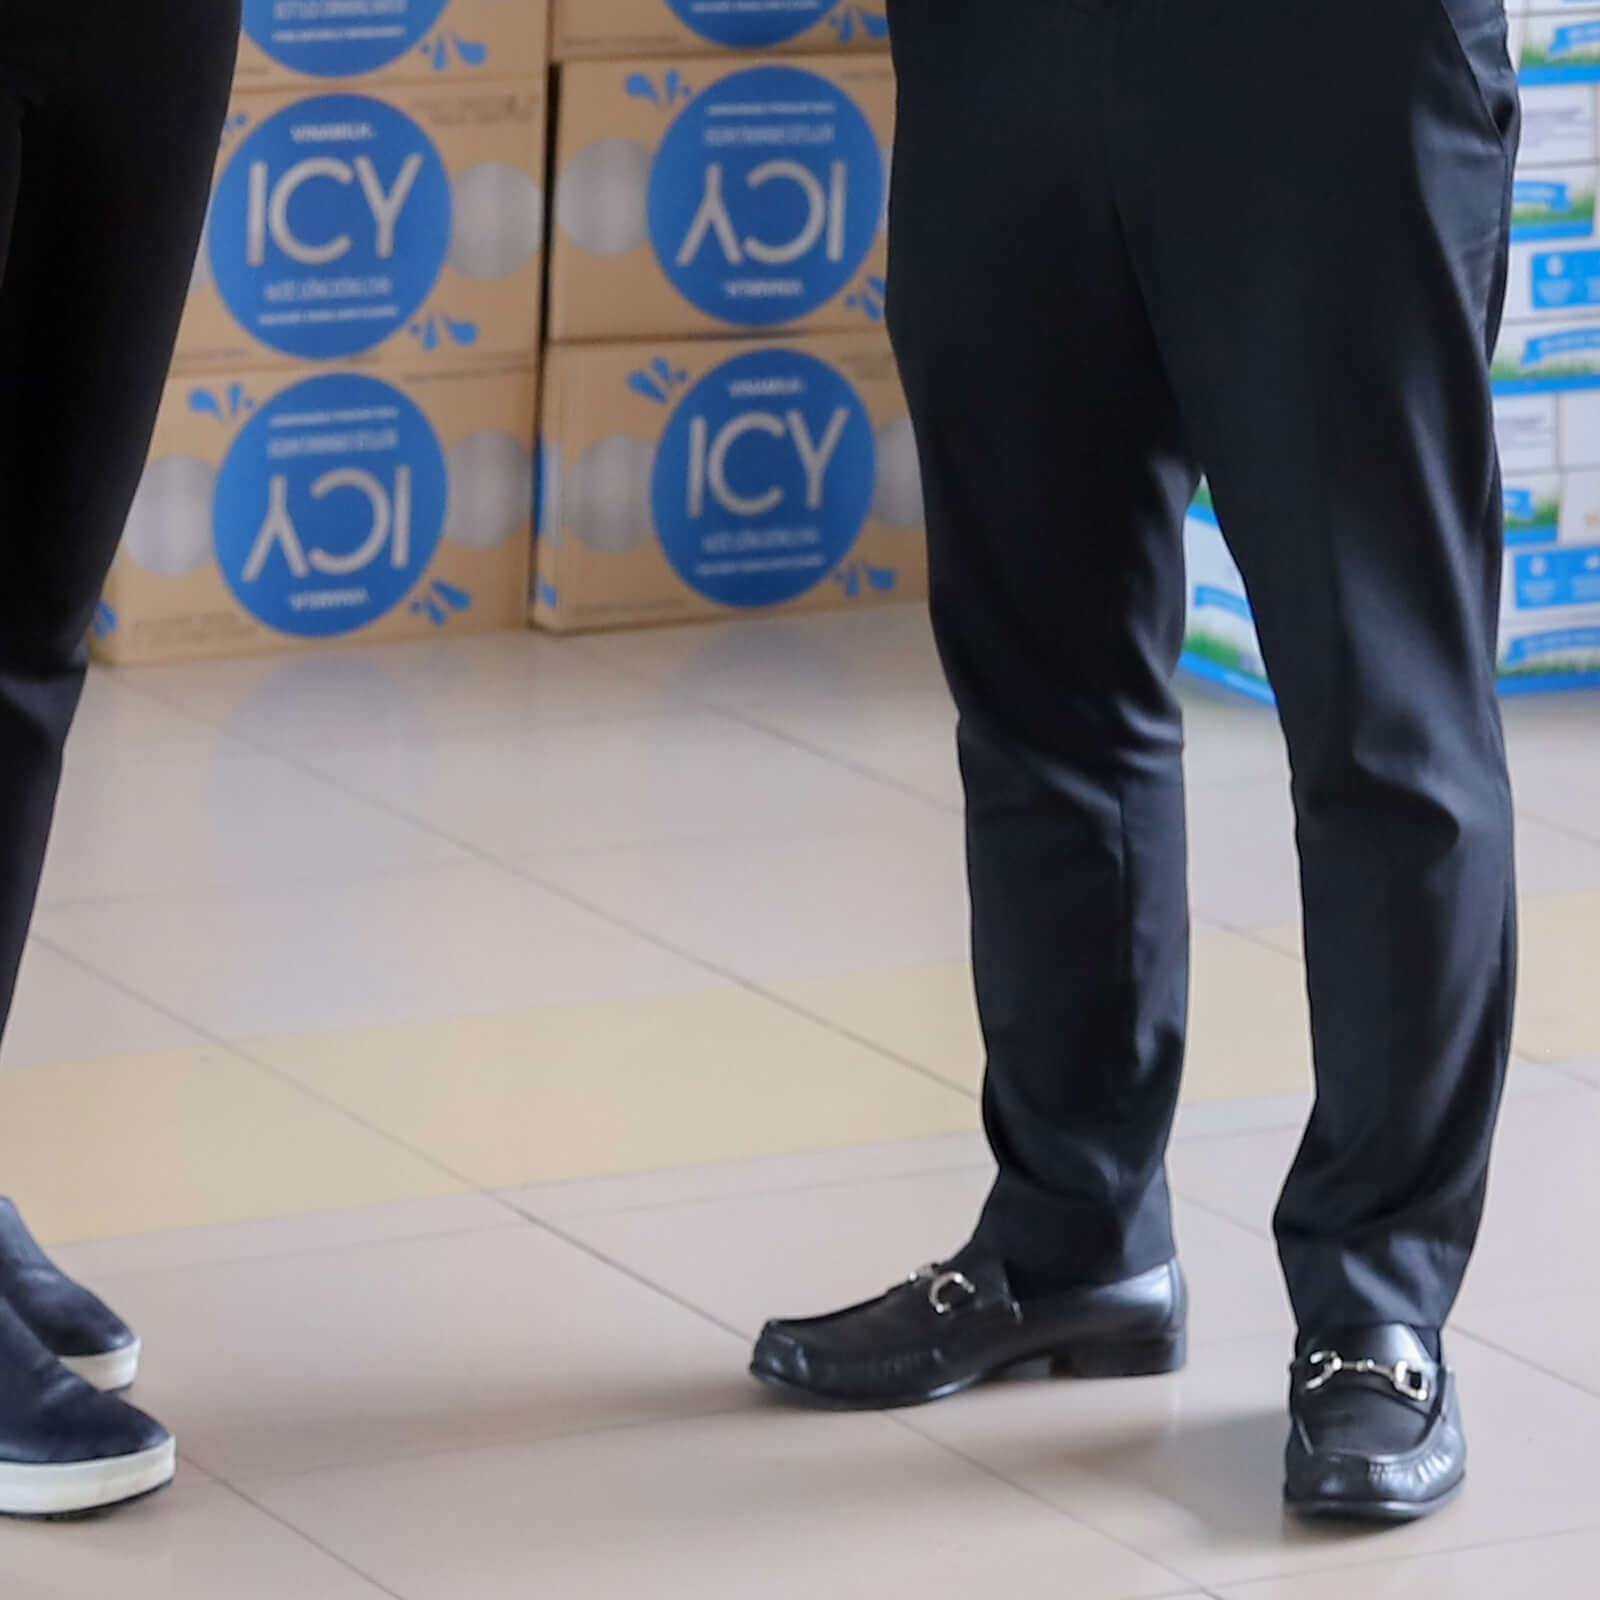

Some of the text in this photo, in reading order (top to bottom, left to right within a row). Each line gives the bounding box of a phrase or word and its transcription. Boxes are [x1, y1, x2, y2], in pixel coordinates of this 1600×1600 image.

[248, 154, 423, 266] ICY
[678, 159, 847, 265] ICY
[688, 408, 849, 517] ICY
[243, 466, 412, 582] ICY
